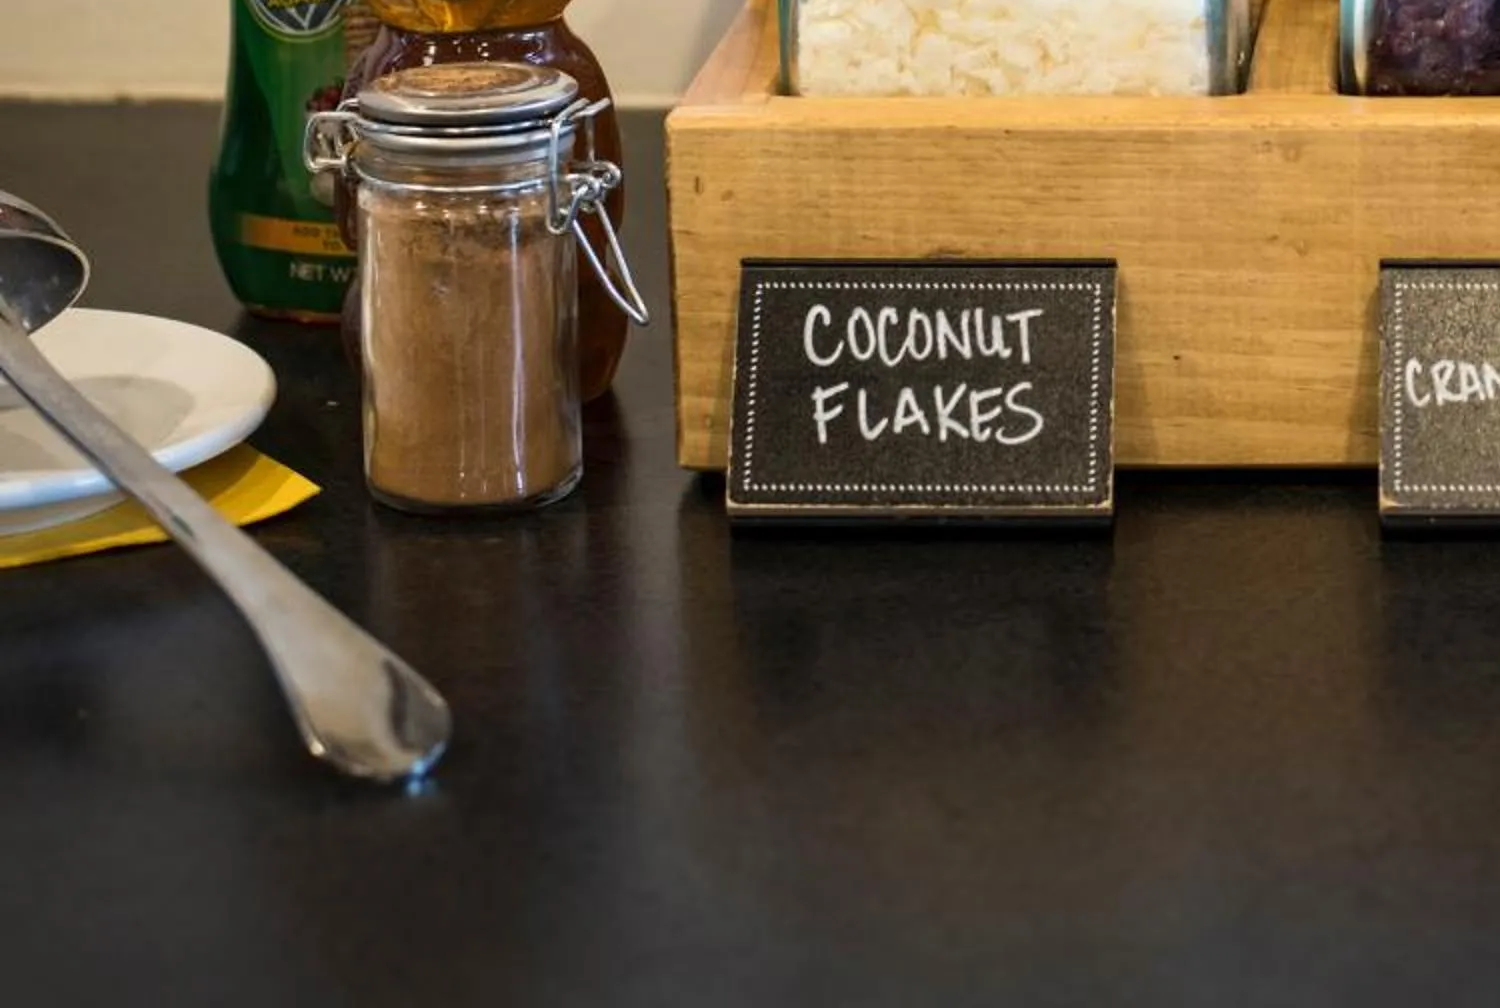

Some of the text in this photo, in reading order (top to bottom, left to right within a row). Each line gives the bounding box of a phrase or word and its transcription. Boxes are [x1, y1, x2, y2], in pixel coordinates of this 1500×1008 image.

[289, 261, 356, 283] NET W
[803, 304, 1044, 367] COCONUT
[811, 381, 1044, 445] FLAKES
